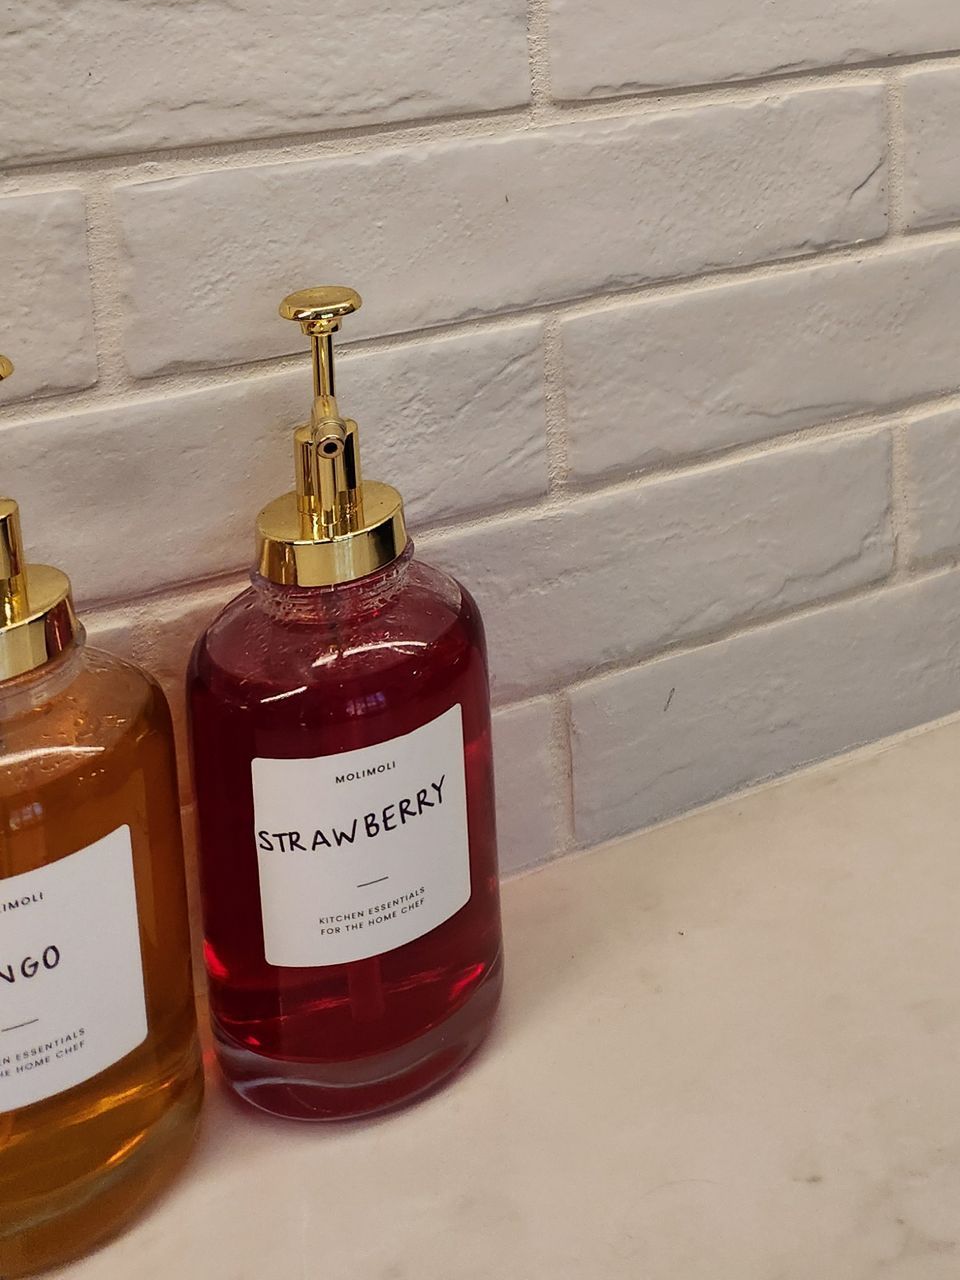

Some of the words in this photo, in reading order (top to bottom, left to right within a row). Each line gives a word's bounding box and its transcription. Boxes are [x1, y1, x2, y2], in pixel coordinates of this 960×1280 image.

[335, 761, 396, 784] MOLIMOLI
[257, 774, 446, 852] STRAWBERRY
[0, 892, 44, 913] IMOLI
[319, 910, 364, 924] KITCHEN
[368, 886, 425, 915] ESSENTIALS
[320, 926, 341, 936] FOR
[345, 921, 363, 932] THE
[368, 910, 397, 926] HOME
[400, 897, 424, 914] CHEF
[16, 1027, 85, 1061] ESSENTIALS
[16, 1056, 51, 1073] HOME
[55, 1040, 84, 1059] CHEF
